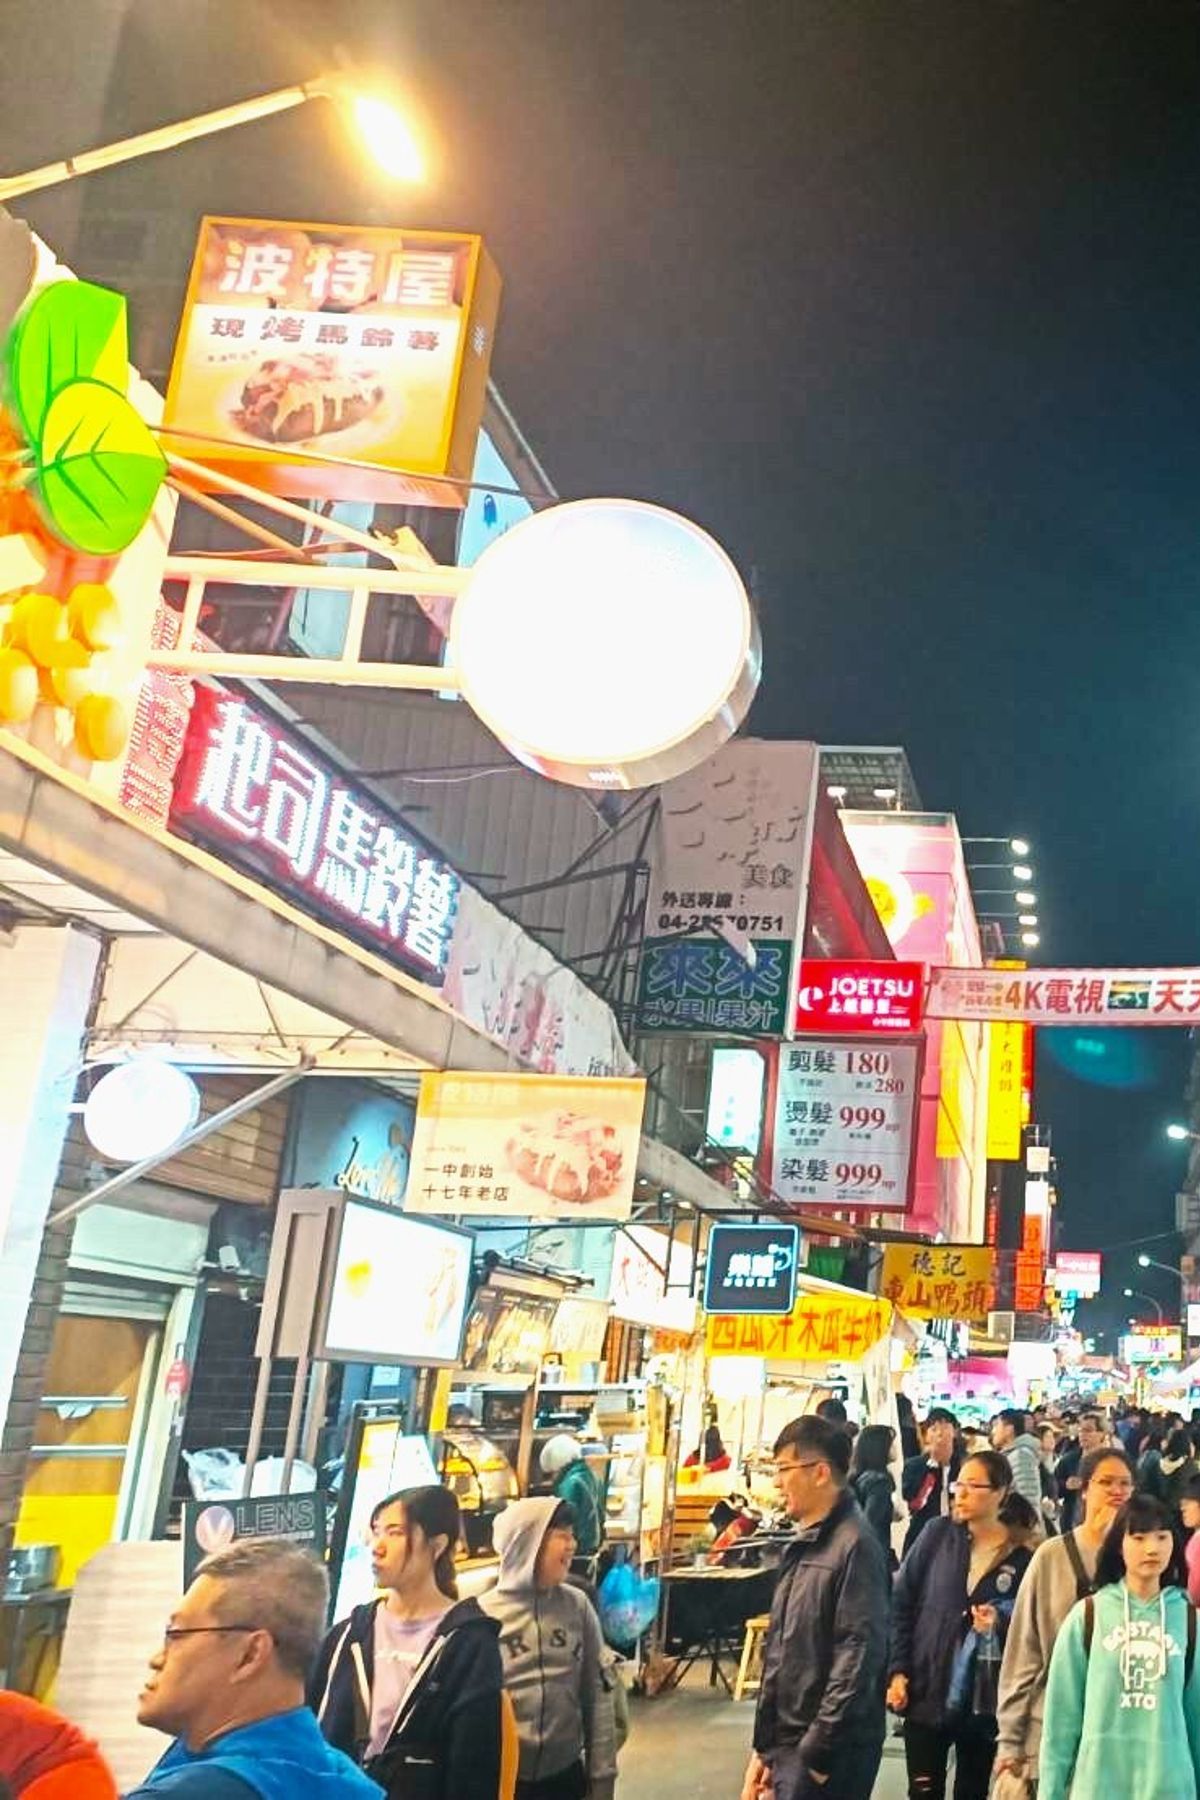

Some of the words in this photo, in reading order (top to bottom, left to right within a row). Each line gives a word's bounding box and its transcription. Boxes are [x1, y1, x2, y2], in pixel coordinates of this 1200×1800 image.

[218, 239, 457, 304] 波特屋
[209, 314, 441, 352] 現烤馬鈴薯
[829, 977, 914, 997] JOETSU
[1004, 978, 1105, 1014] 4K電視
[845, 1052, 890, 1075] 180
[874, 1078, 905, 1094] 280
[839, 1106, 886, 1130] 999
[423, 1163, 494, 1178] 一中創始
[780, 1158, 831, 1182] 染髮
[834, 1163, 883, 1187] 999
[422, 1185, 510, 1202] 十七年老店
[236, 1501, 315, 1535] LENS
[1120, 1692, 1157, 1710] XTO
